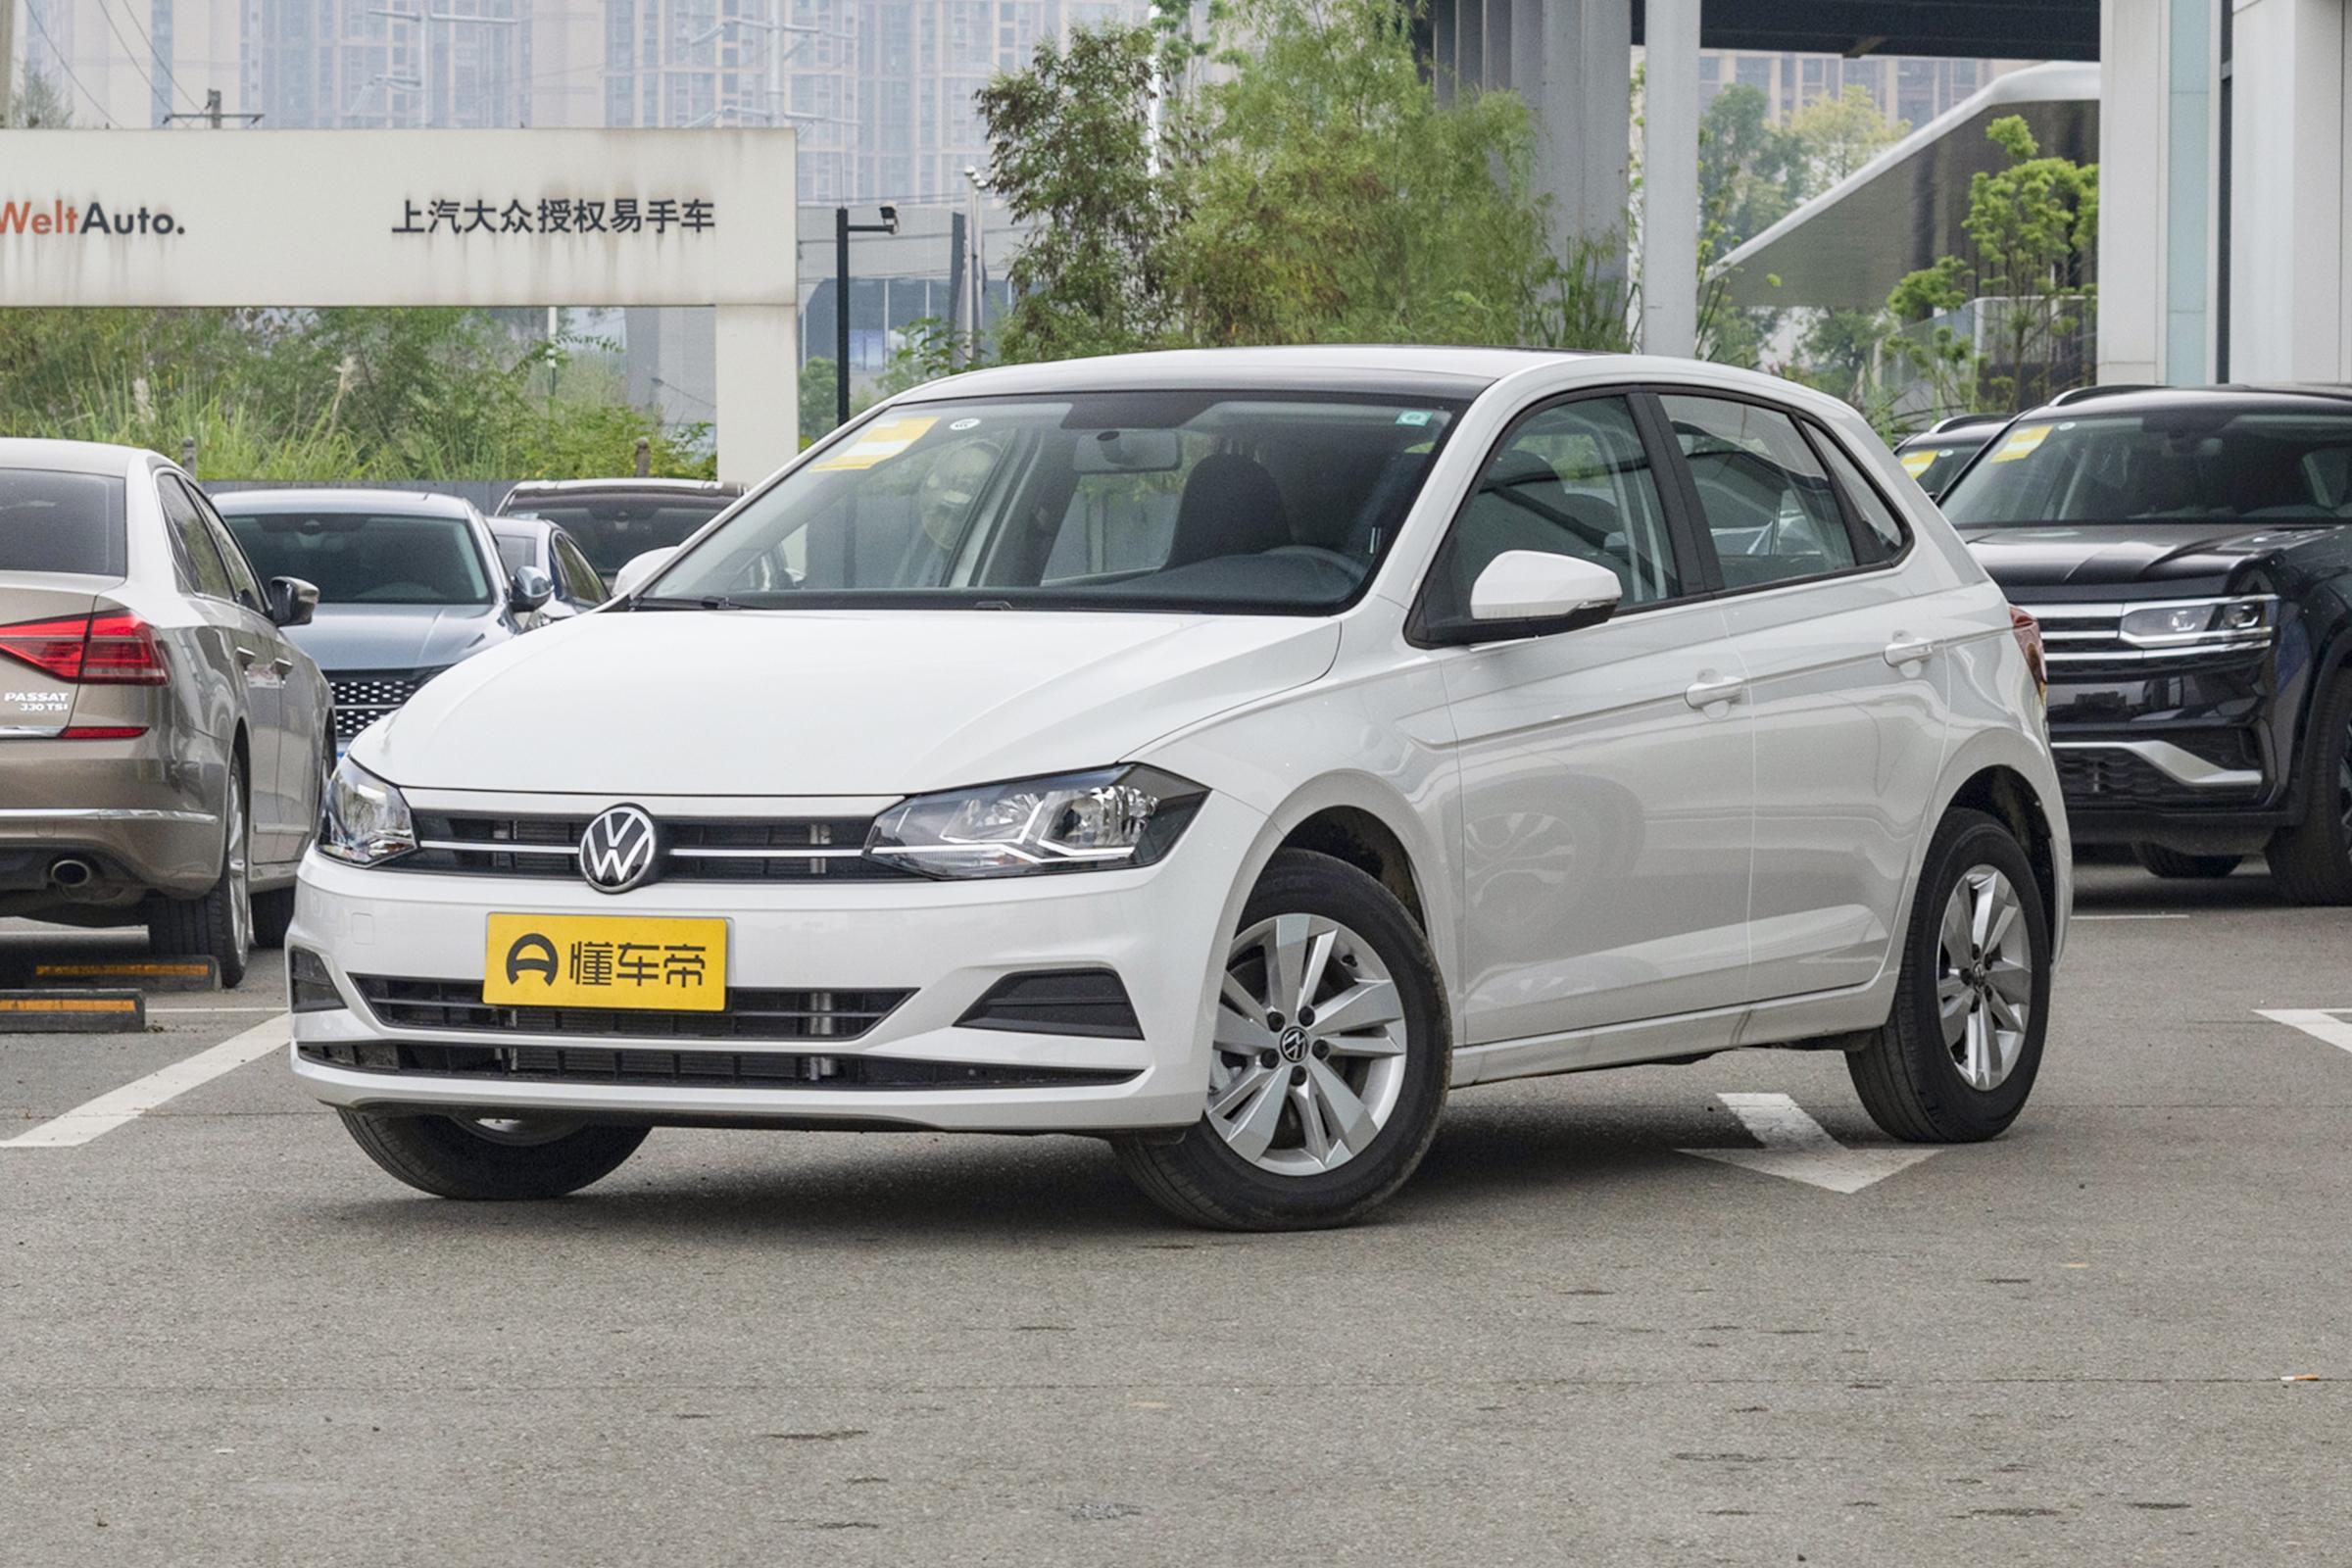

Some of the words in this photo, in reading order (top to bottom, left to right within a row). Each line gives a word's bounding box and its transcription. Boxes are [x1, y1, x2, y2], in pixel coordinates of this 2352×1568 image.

[391, 199, 715, 233] 上汽大众授权易手车
[4, 692, 69, 702] PASSAT
[569, 941, 706, 988] 懂车帝
